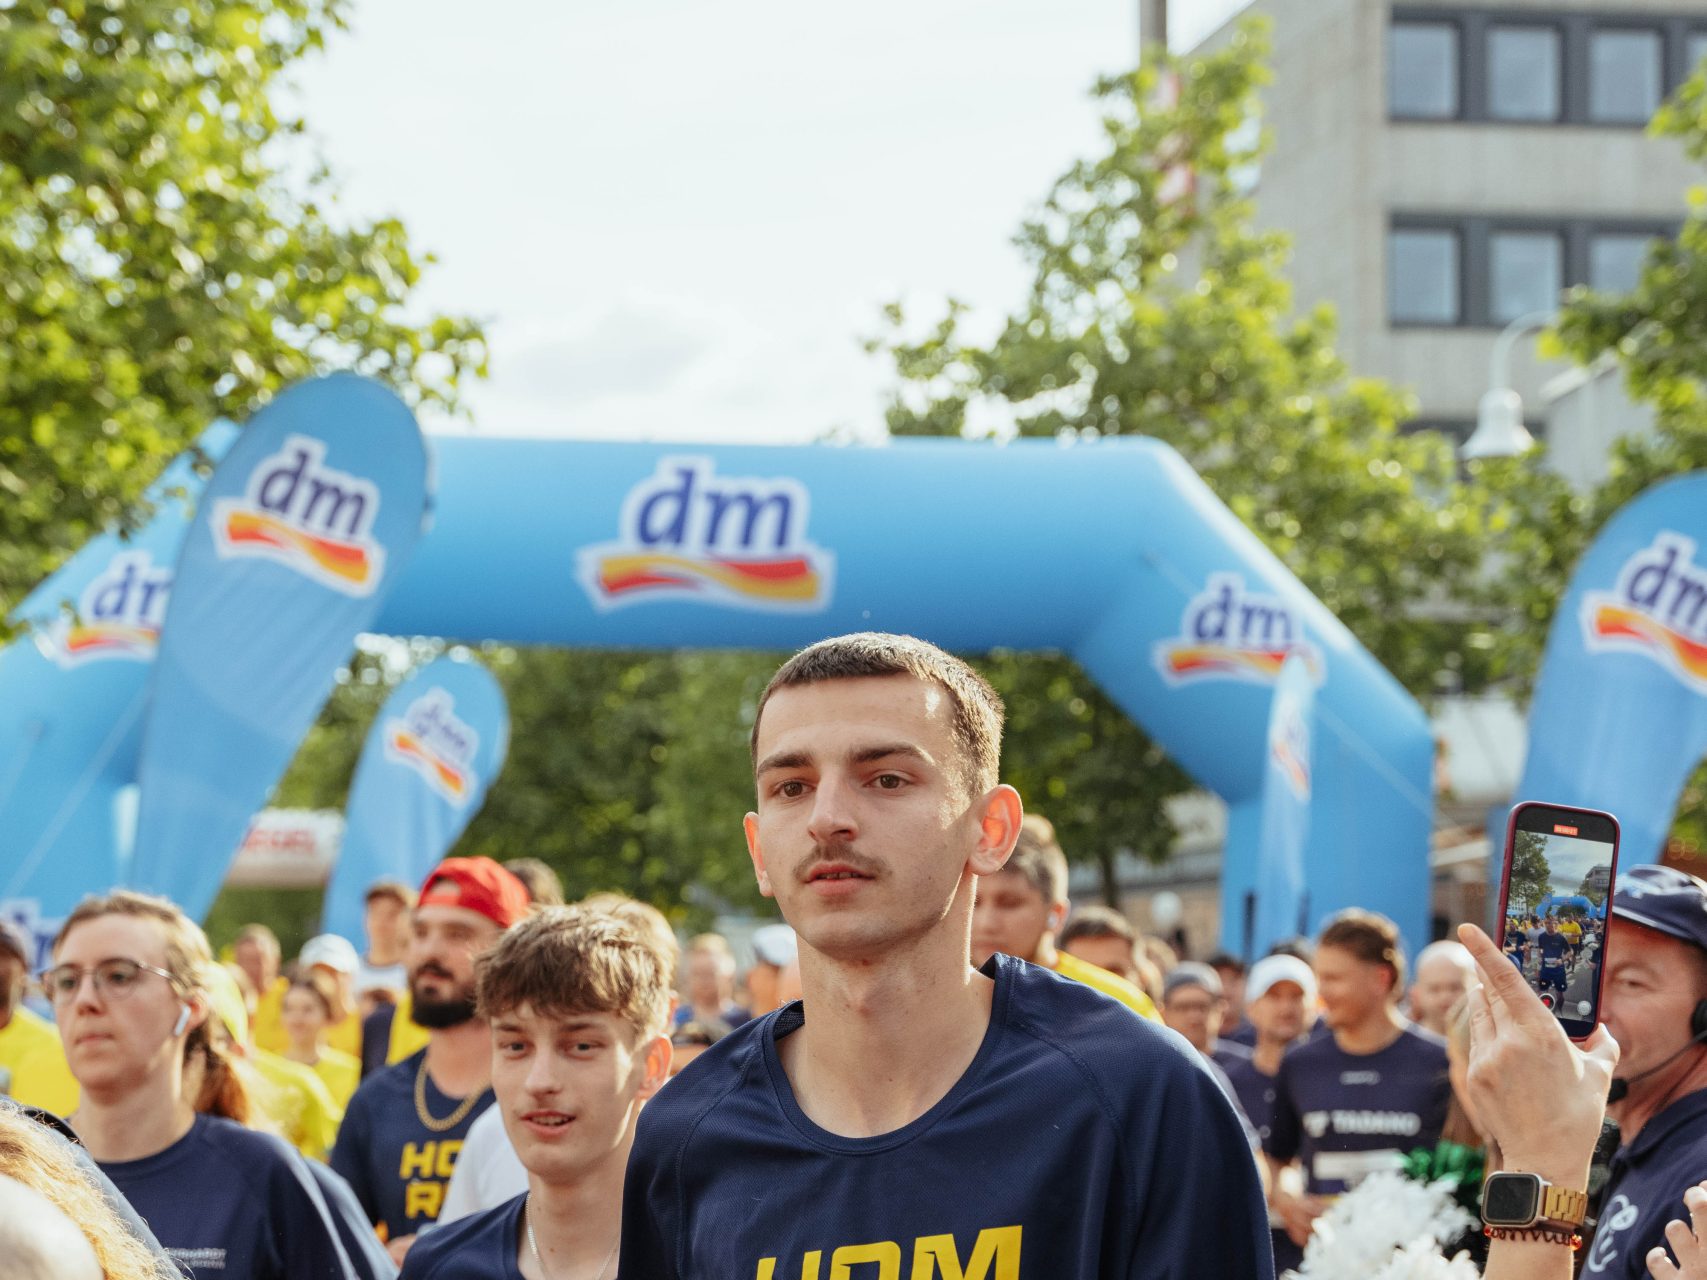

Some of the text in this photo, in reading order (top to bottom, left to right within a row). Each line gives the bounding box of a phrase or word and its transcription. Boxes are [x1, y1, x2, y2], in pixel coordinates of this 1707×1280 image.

[258, 449, 366, 535] dm
[637, 467, 793, 548] dm
[1193, 584, 1293, 642] dm
[400, 1139, 464, 1179] HO
